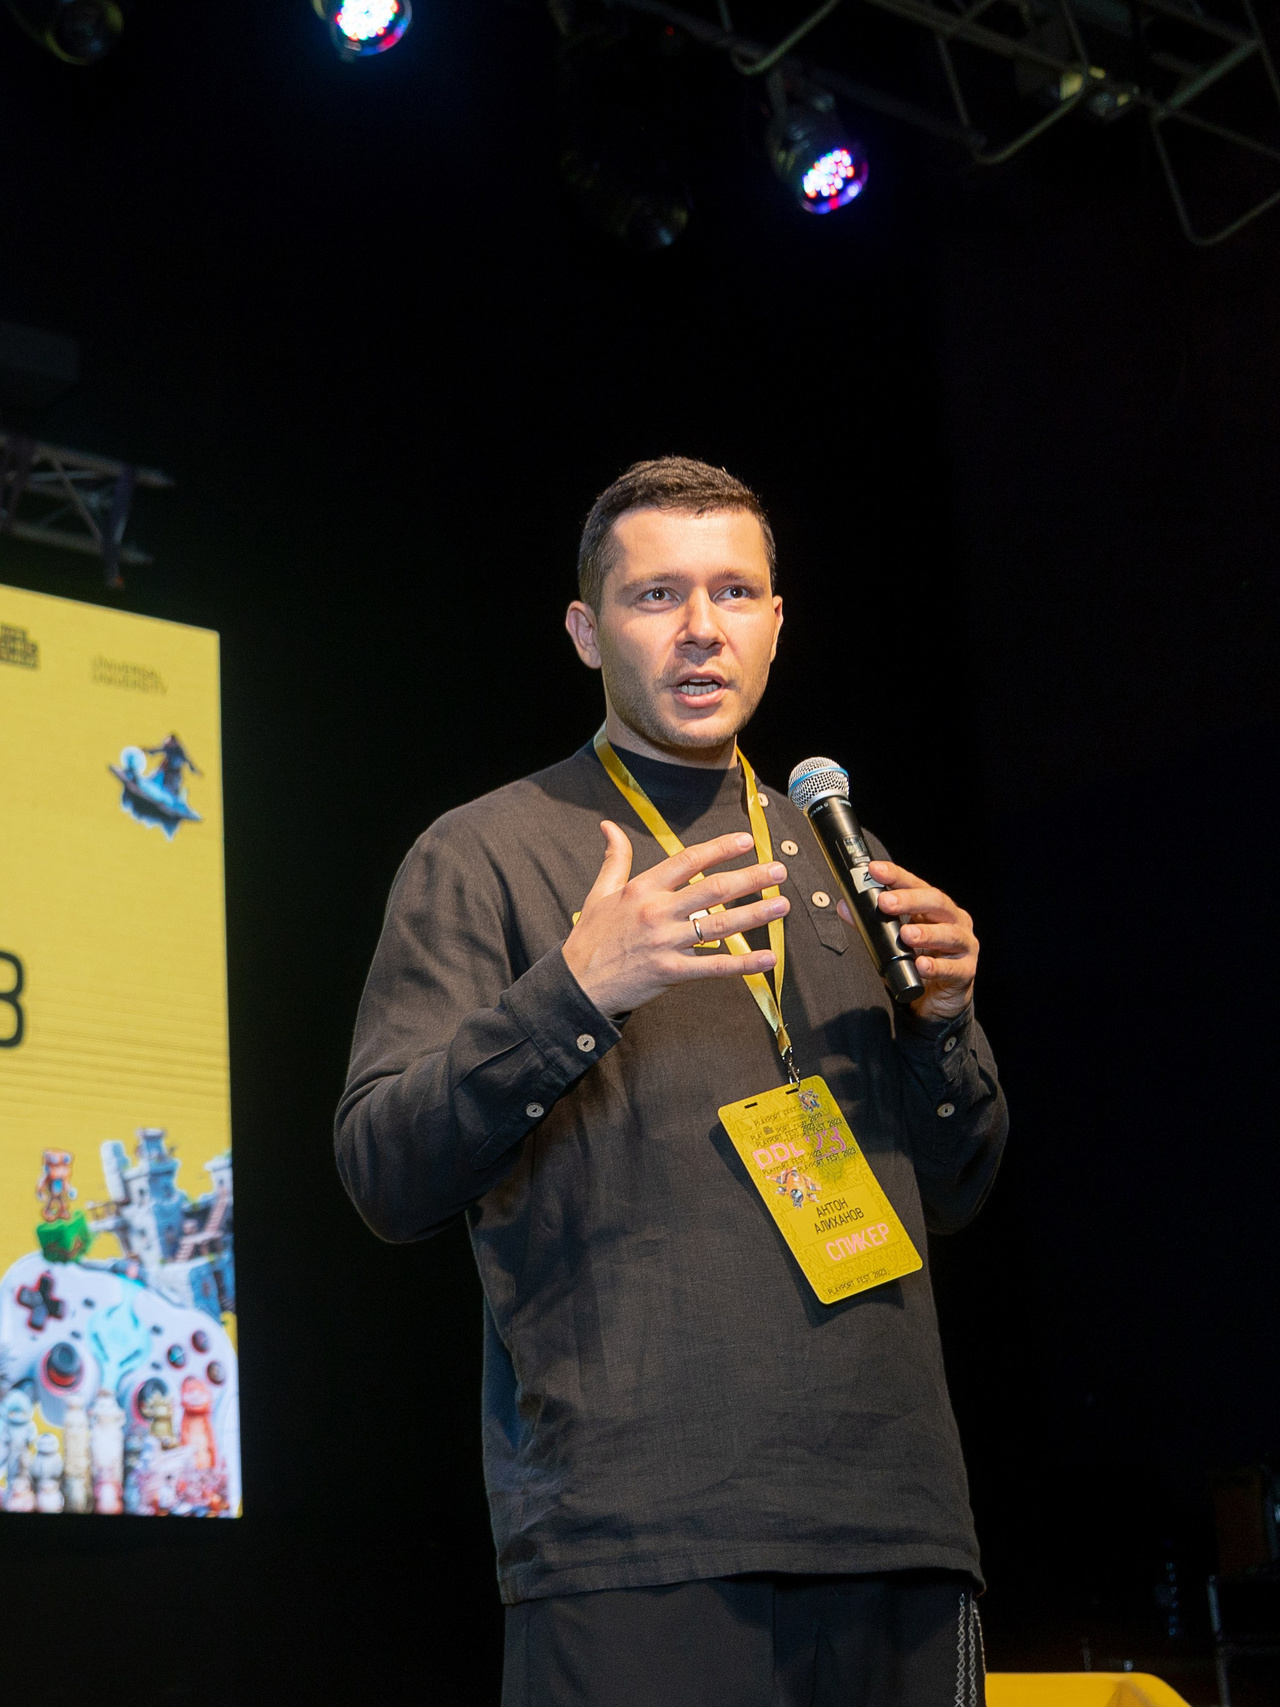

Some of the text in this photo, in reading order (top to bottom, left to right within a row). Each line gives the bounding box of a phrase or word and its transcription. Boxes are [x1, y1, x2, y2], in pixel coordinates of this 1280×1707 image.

[785, 1129, 799, 1138] FEST
[791, 1155, 806, 1165] FEST
[797, 1147, 857, 1172] PLAYPORT FEST 2023
[816, 1197, 849, 1218] АНТОН
[813, 1207, 865, 1235] АЛИХАНОВ
[825, 1222, 890, 1261] СПИКЕР
[827, 1267, 887, 1295] PLAYPORT FEST 2023
